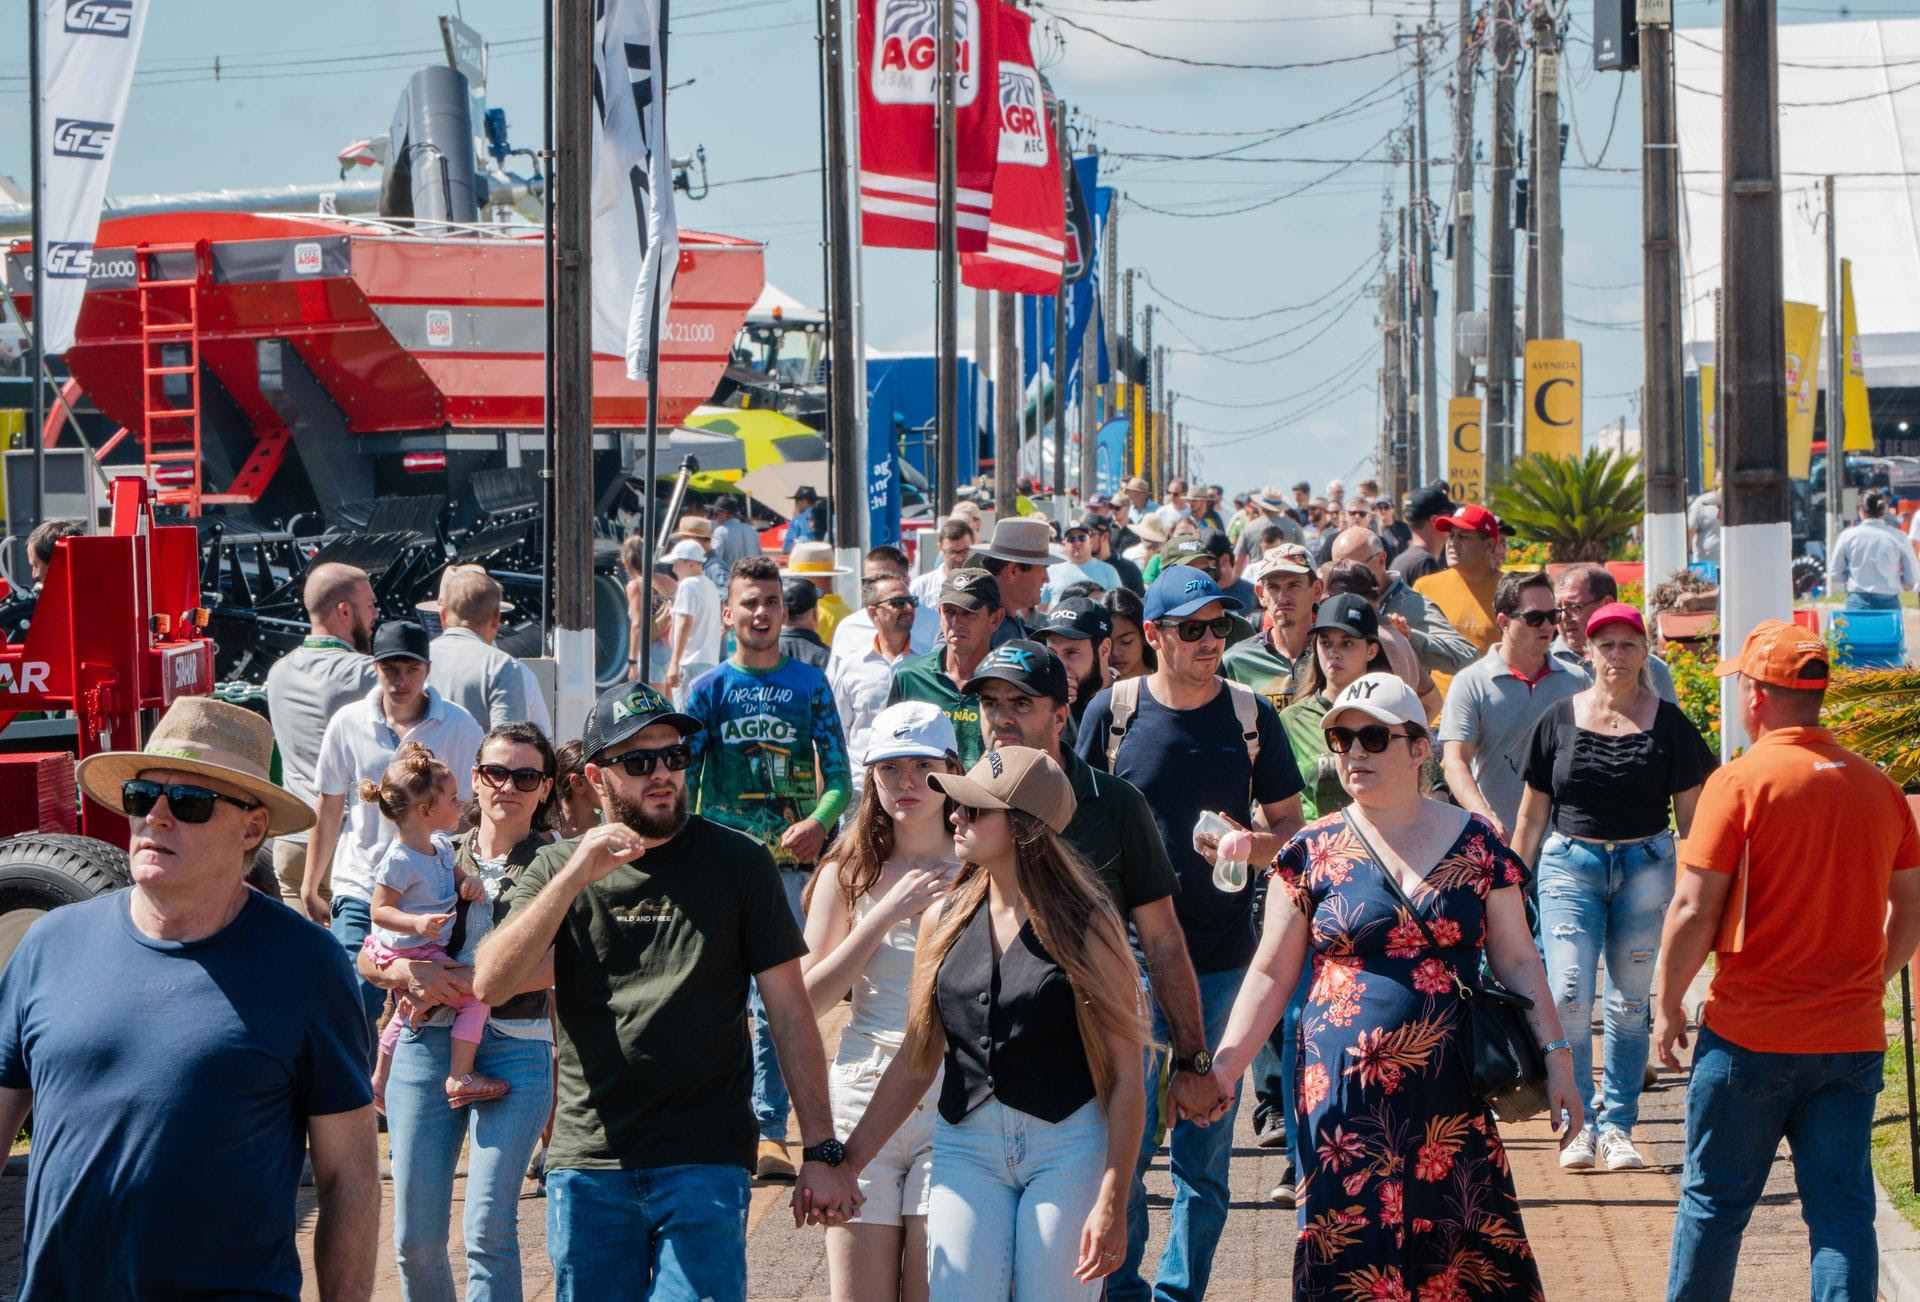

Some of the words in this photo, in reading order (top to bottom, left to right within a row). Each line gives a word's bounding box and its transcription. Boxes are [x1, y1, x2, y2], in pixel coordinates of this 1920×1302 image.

[65, 0, 132, 31] GTS
[881, 37, 969, 73] AGI
[1000, 104, 1041, 137] GRI
[55, 121, 113, 154] GTS
[47, 243, 93, 274] GTS
[1532, 361, 1576, 370] AVENIDA
[1534, 378, 1575, 427] C
[1454, 422, 1480, 453] C
[1451, 468, 1480, 479] RUA
[1451, 483, 1479, 502] 05
[728, 686, 793, 703] ORGULHO
[1346, 681, 1379, 701] NY
[953, 709, 978, 721] NÃO
[724, 720, 789, 740] AGRO
